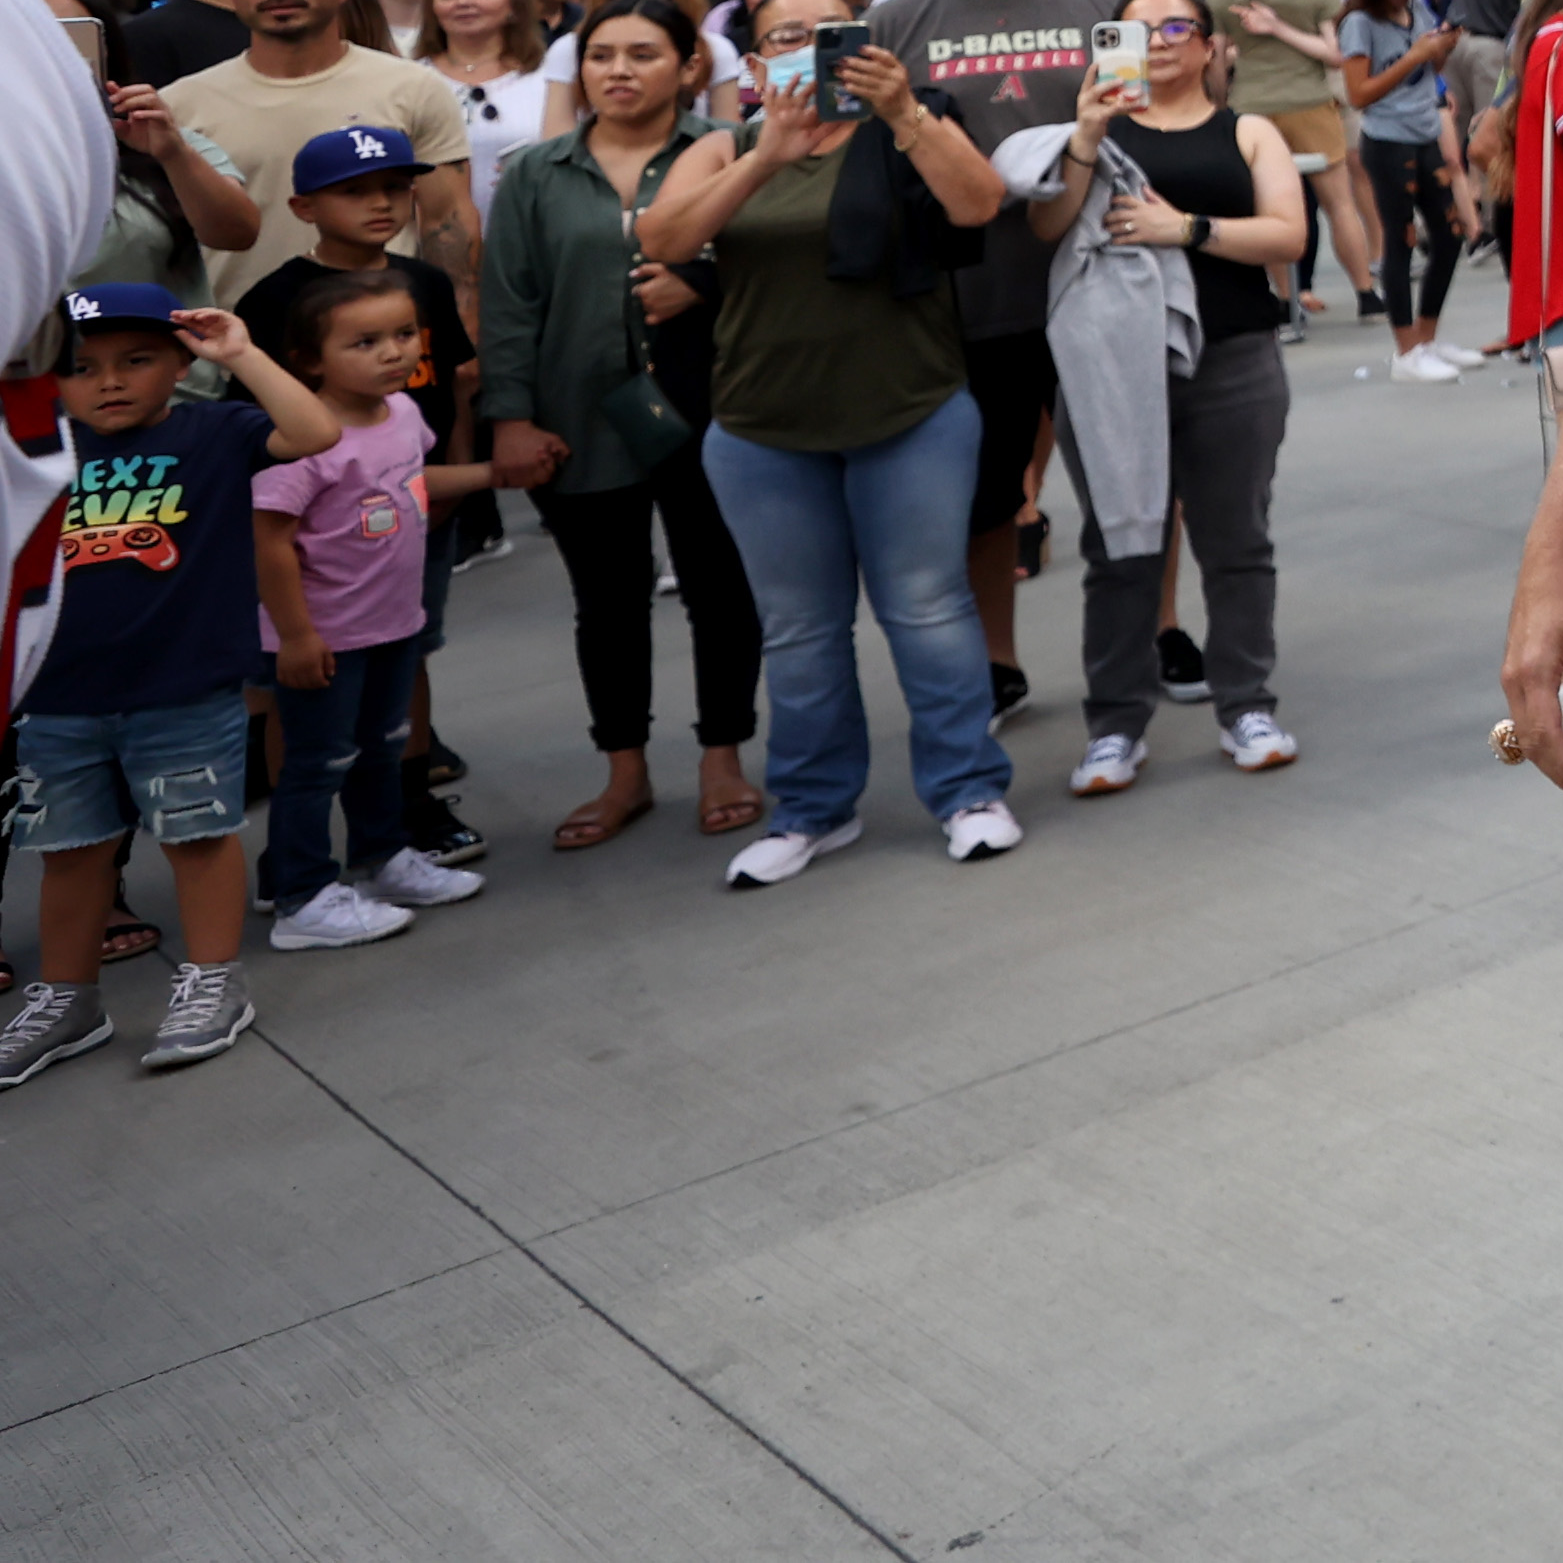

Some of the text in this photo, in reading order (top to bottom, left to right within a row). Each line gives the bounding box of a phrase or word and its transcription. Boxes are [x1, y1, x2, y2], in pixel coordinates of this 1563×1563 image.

[928, 26, 1083, 63] D-BACKS
[934, 50, 1080, 79] BASEBALL
[348, 130, 388, 159] LA
[66, 292, 102, 321] LA
